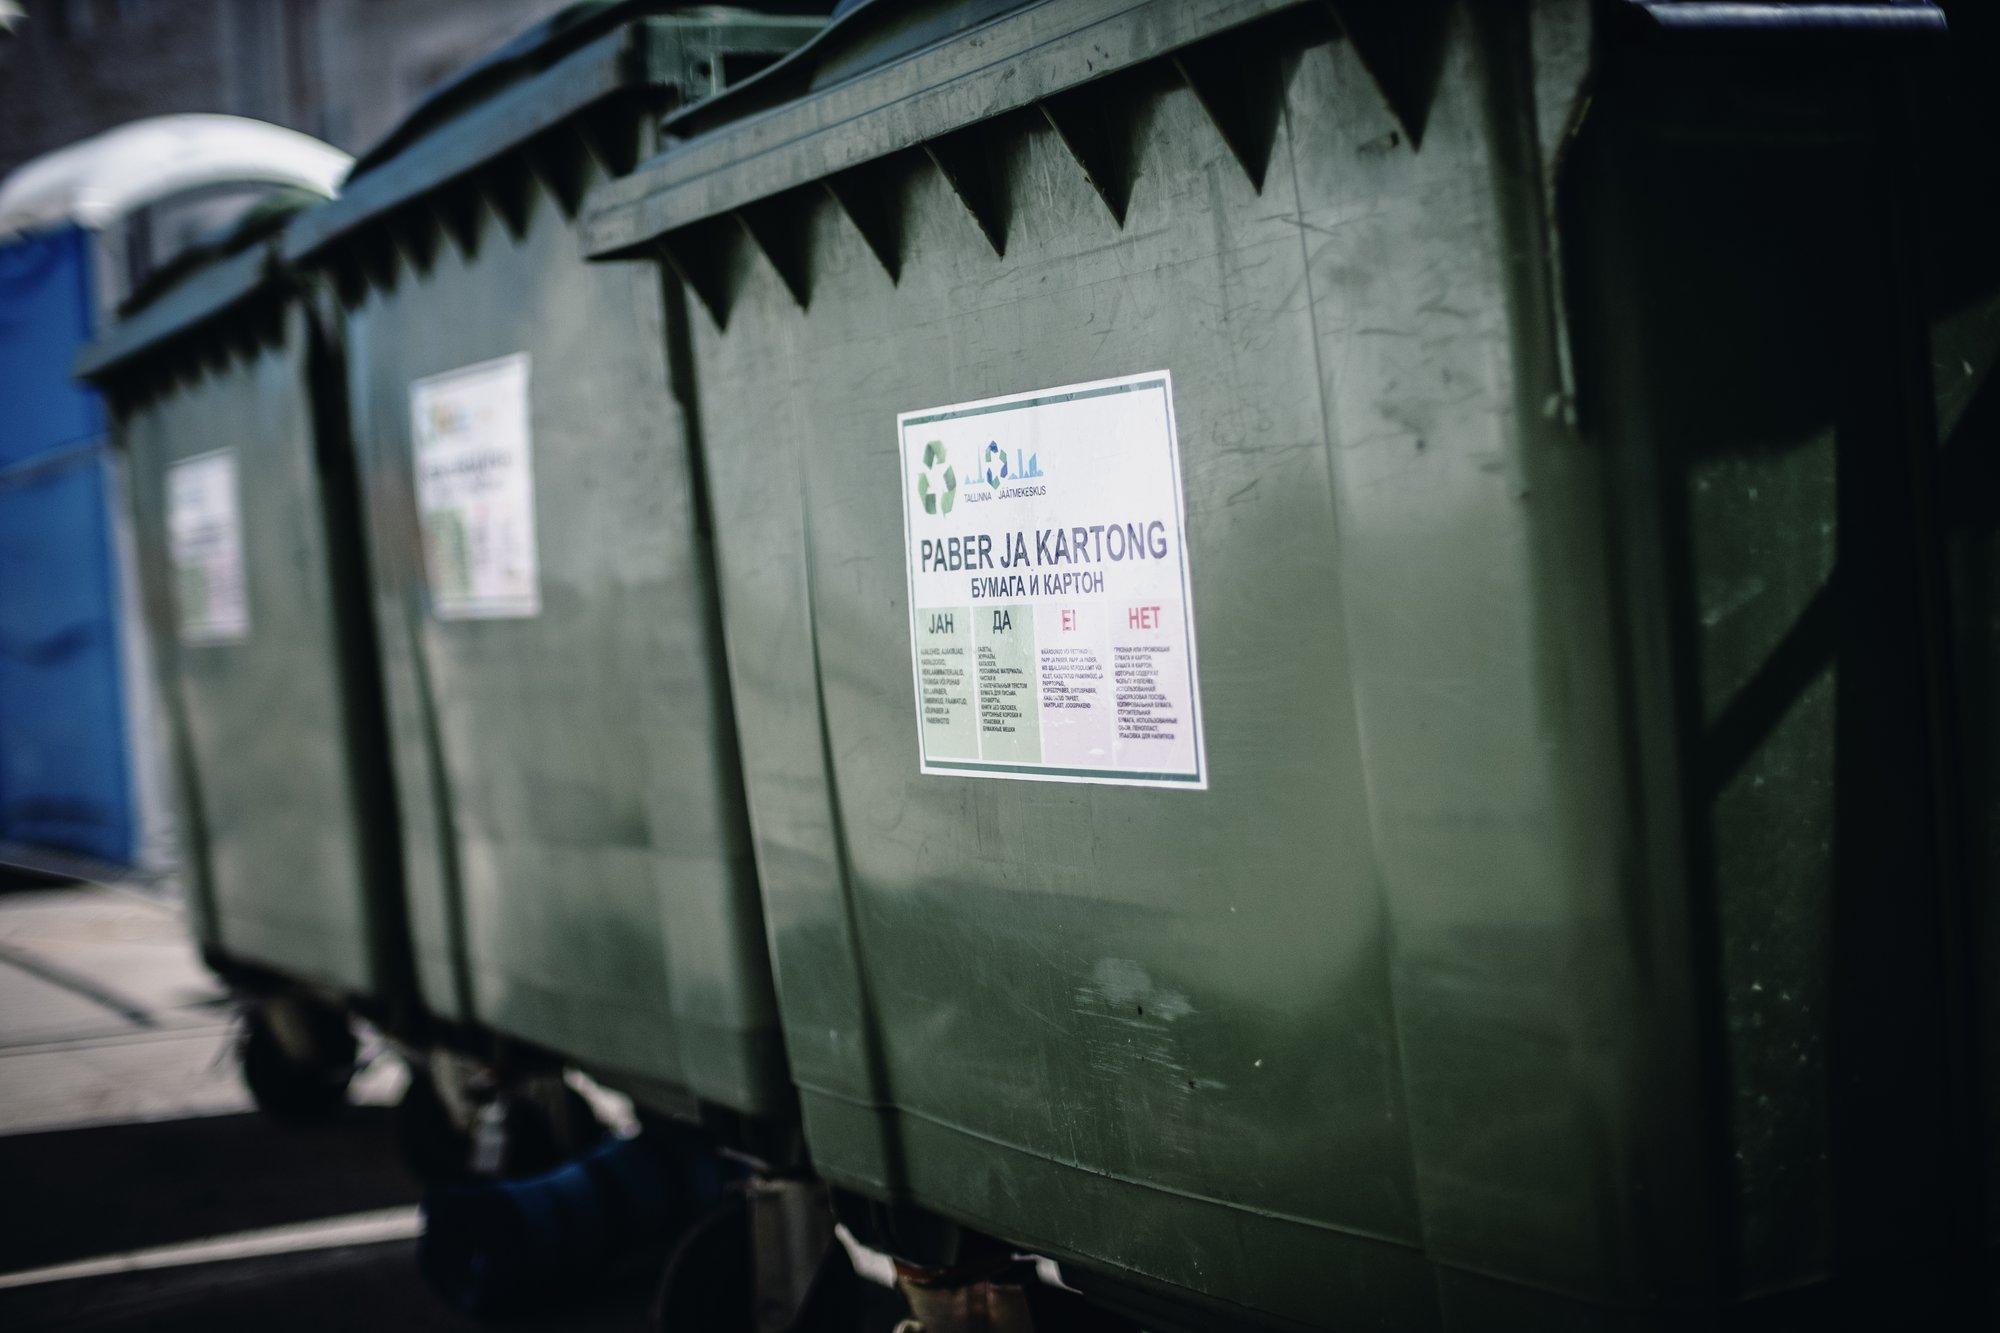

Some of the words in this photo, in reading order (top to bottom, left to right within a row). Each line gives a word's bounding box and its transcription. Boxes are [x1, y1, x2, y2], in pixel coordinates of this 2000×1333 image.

[964, 492, 992, 502] TALLINNA
[998, 485, 1046, 500] JÄÄTMEKESKUS
[921, 534, 994, 573] PABER
[1000, 531, 1030, 568] JA
[1036, 520, 1167, 566] KARTONG
[971, 575, 1026, 598] БУМАГА
[1030, 574, 1039, 596] И
[1043, 571, 1104, 595] КАРТОН
[928, 613, 954, 634] JAH
[992, 610, 1012, 634] ДА
[1061, 609, 1076, 631] EI
[1128, 606, 1160, 629] НЕТ
